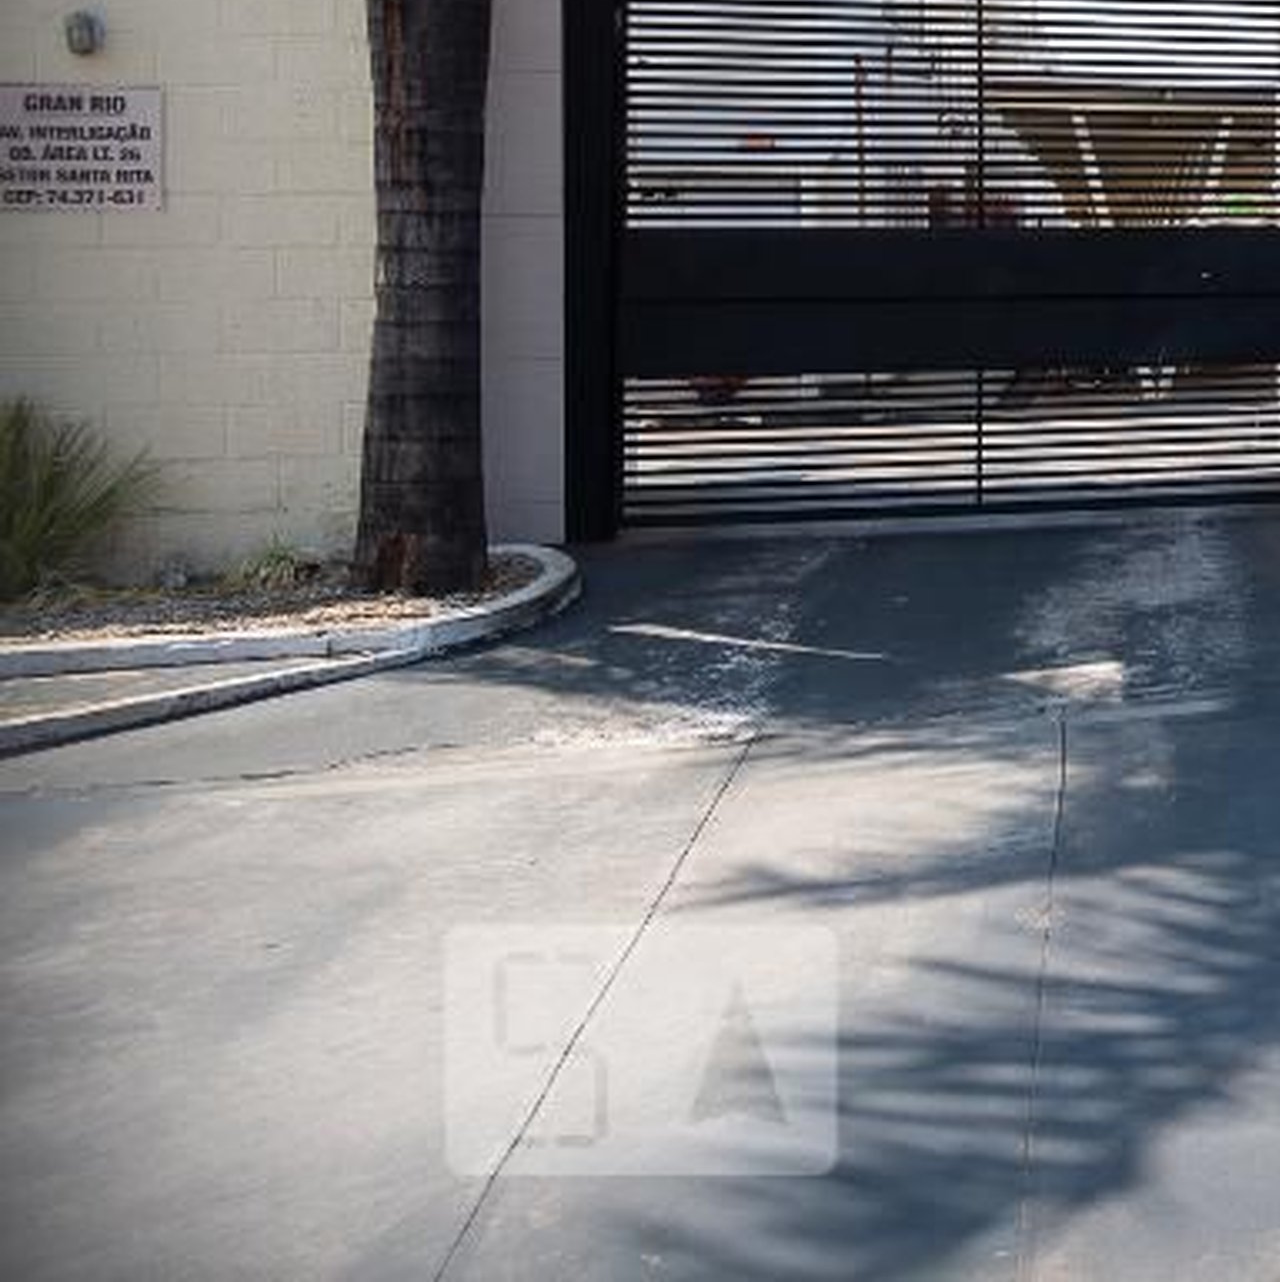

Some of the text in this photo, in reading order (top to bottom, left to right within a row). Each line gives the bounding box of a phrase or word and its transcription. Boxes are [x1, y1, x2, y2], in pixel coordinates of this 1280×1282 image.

[23, 94, 126, 114] GRAN RIO
[56, 169, 111, 183] SANTA
